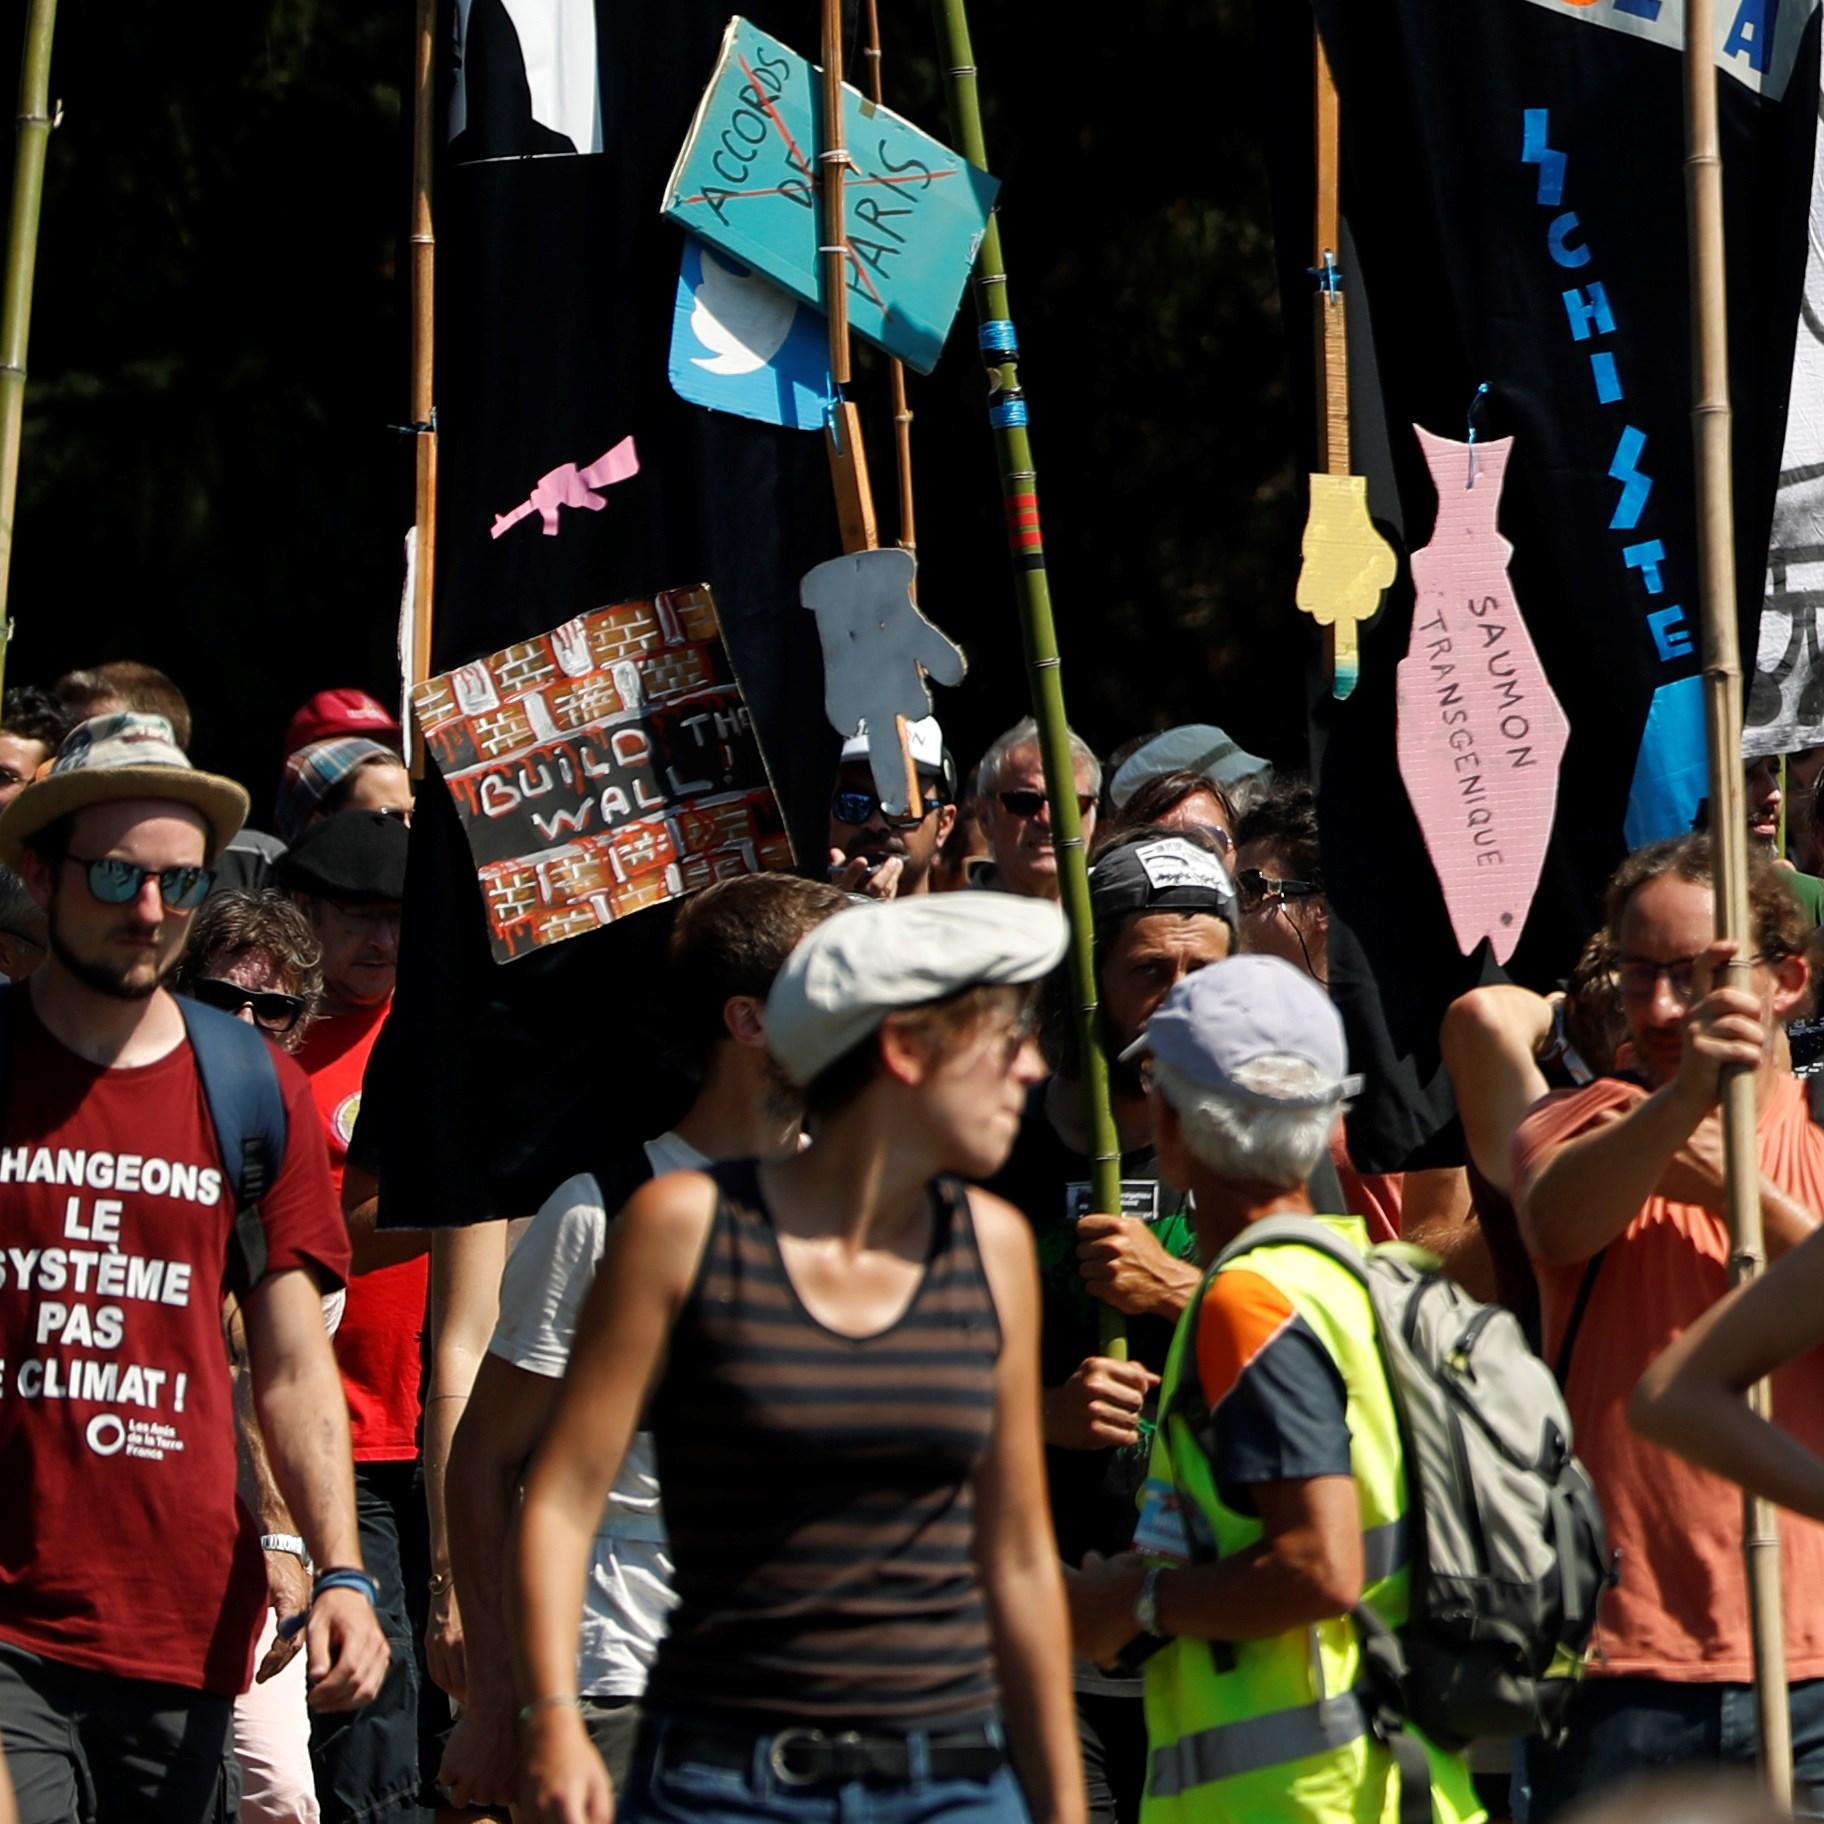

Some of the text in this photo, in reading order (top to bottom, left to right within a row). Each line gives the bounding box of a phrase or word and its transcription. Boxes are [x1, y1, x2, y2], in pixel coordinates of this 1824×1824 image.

[701, 46, 791, 227] ACCORDS
[1521, 108, 1695, 663] SCHISTE
[1418, 608, 1505, 868] TRANSGENIQUE
[1467, 595, 1538, 769] SAUMON
[479, 728, 652, 818] BUILD
[63, 1196, 124, 1243] LE
[17, 1358, 166, 1409] CLIMAT
[36, 1301, 125, 1350] PAS
